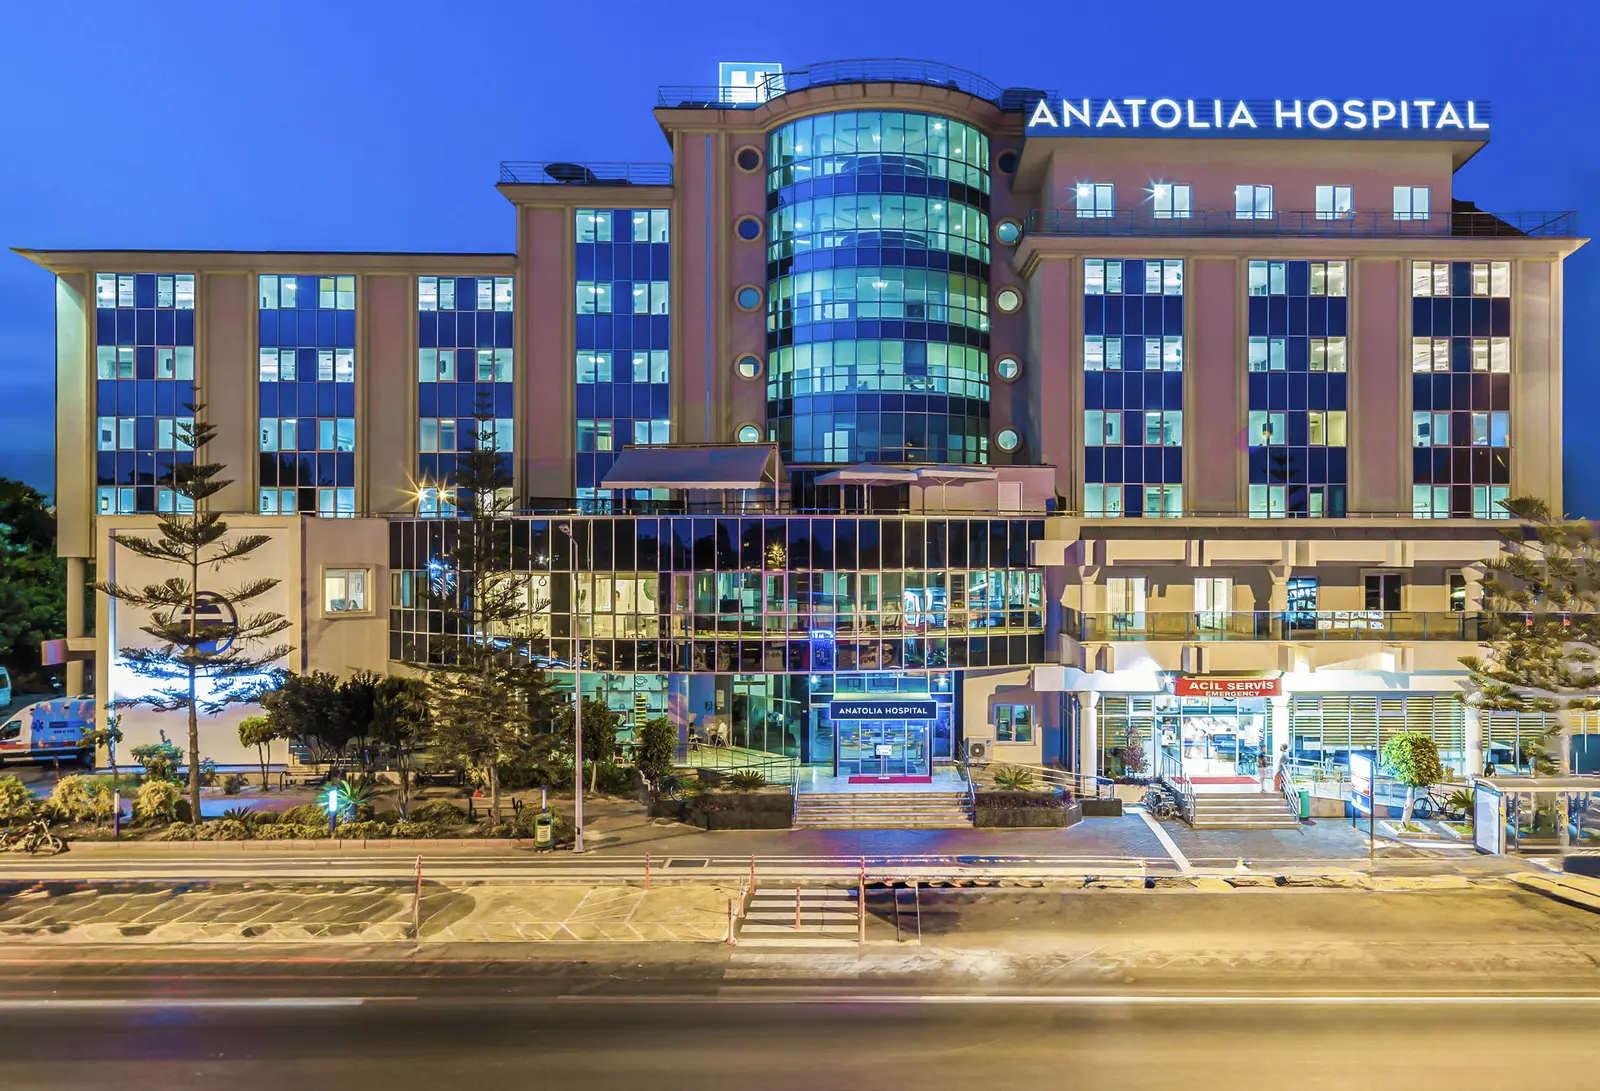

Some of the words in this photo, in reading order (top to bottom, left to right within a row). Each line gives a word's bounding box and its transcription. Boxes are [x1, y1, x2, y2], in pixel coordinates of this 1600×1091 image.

[1028, 98, 1258, 129] ANATOLIA
[1275, 99, 1490, 129] HOSPITAL
[839, 707, 883, 715] ANATOLIA
[885, 707, 928, 715] HOSPITAL
